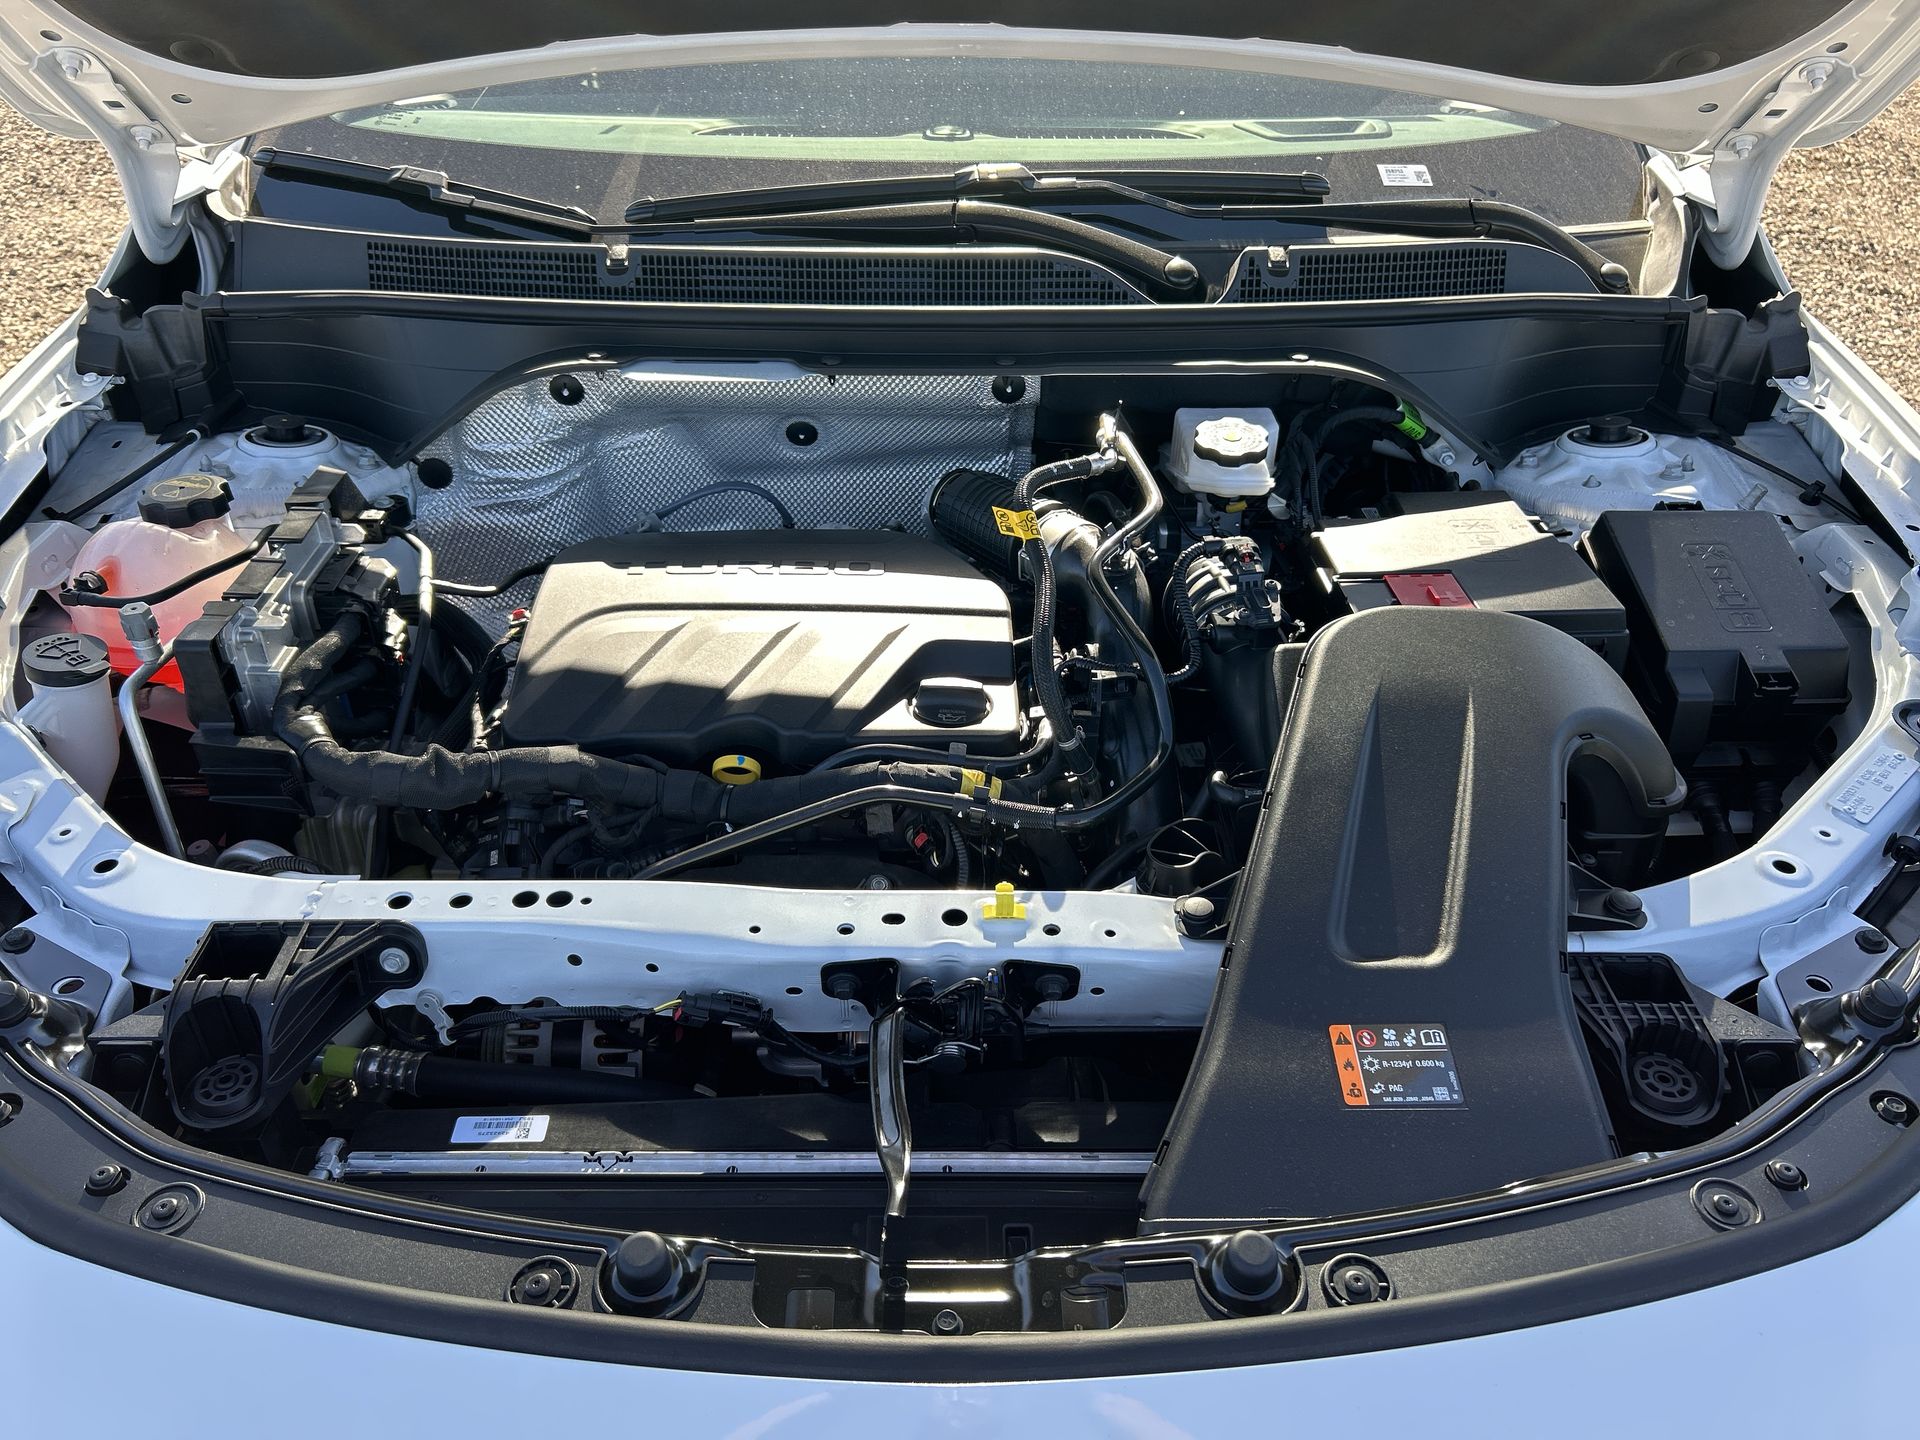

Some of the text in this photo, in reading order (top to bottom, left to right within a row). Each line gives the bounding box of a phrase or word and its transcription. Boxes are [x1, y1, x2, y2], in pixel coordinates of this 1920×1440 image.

[612, 560, 885, 576] TURBO
[1382, 1060, 1445, 1069] R-1234yf 0.600 kg
[1388, 1084, 1404, 1092] PAG
